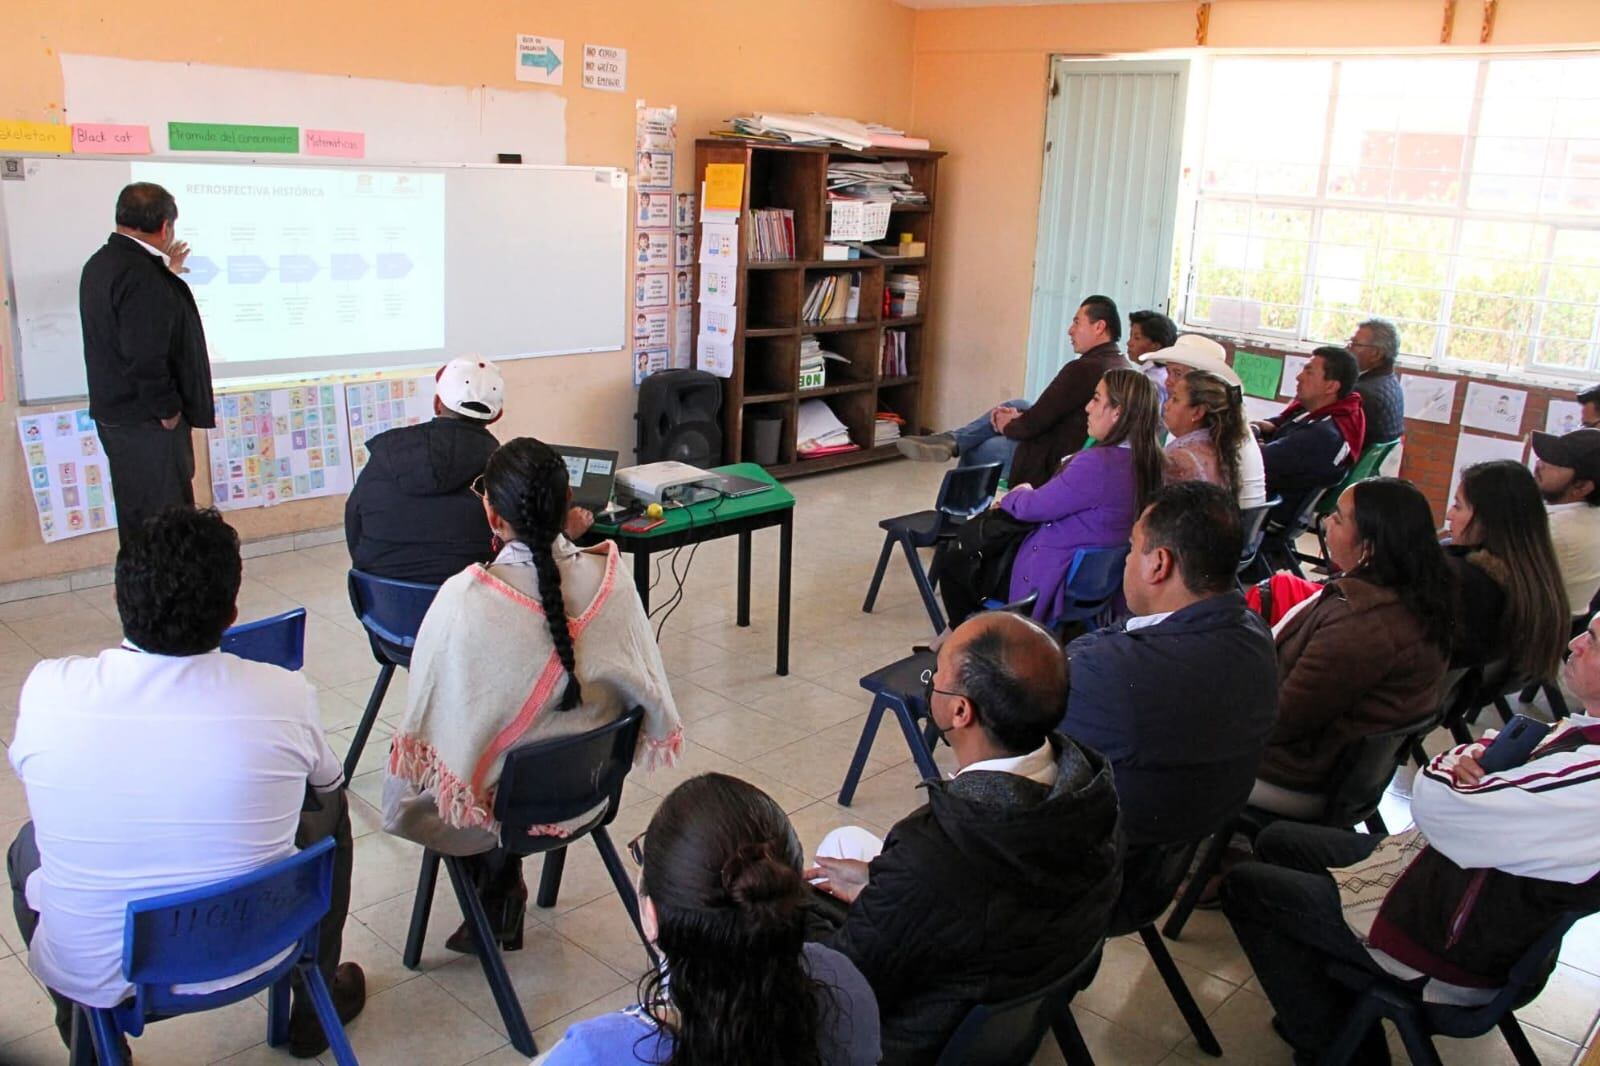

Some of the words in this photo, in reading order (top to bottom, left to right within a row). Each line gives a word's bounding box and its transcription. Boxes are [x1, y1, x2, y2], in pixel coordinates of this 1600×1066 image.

[586, 47, 596, 57] NO
[585, 61, 594, 71] NO
[585, 75, 594, 84] NO
[77, 128, 106, 143] Black
[114, 131, 132, 143] cat
[186, 183, 270, 197] RETROSPECTIVA
